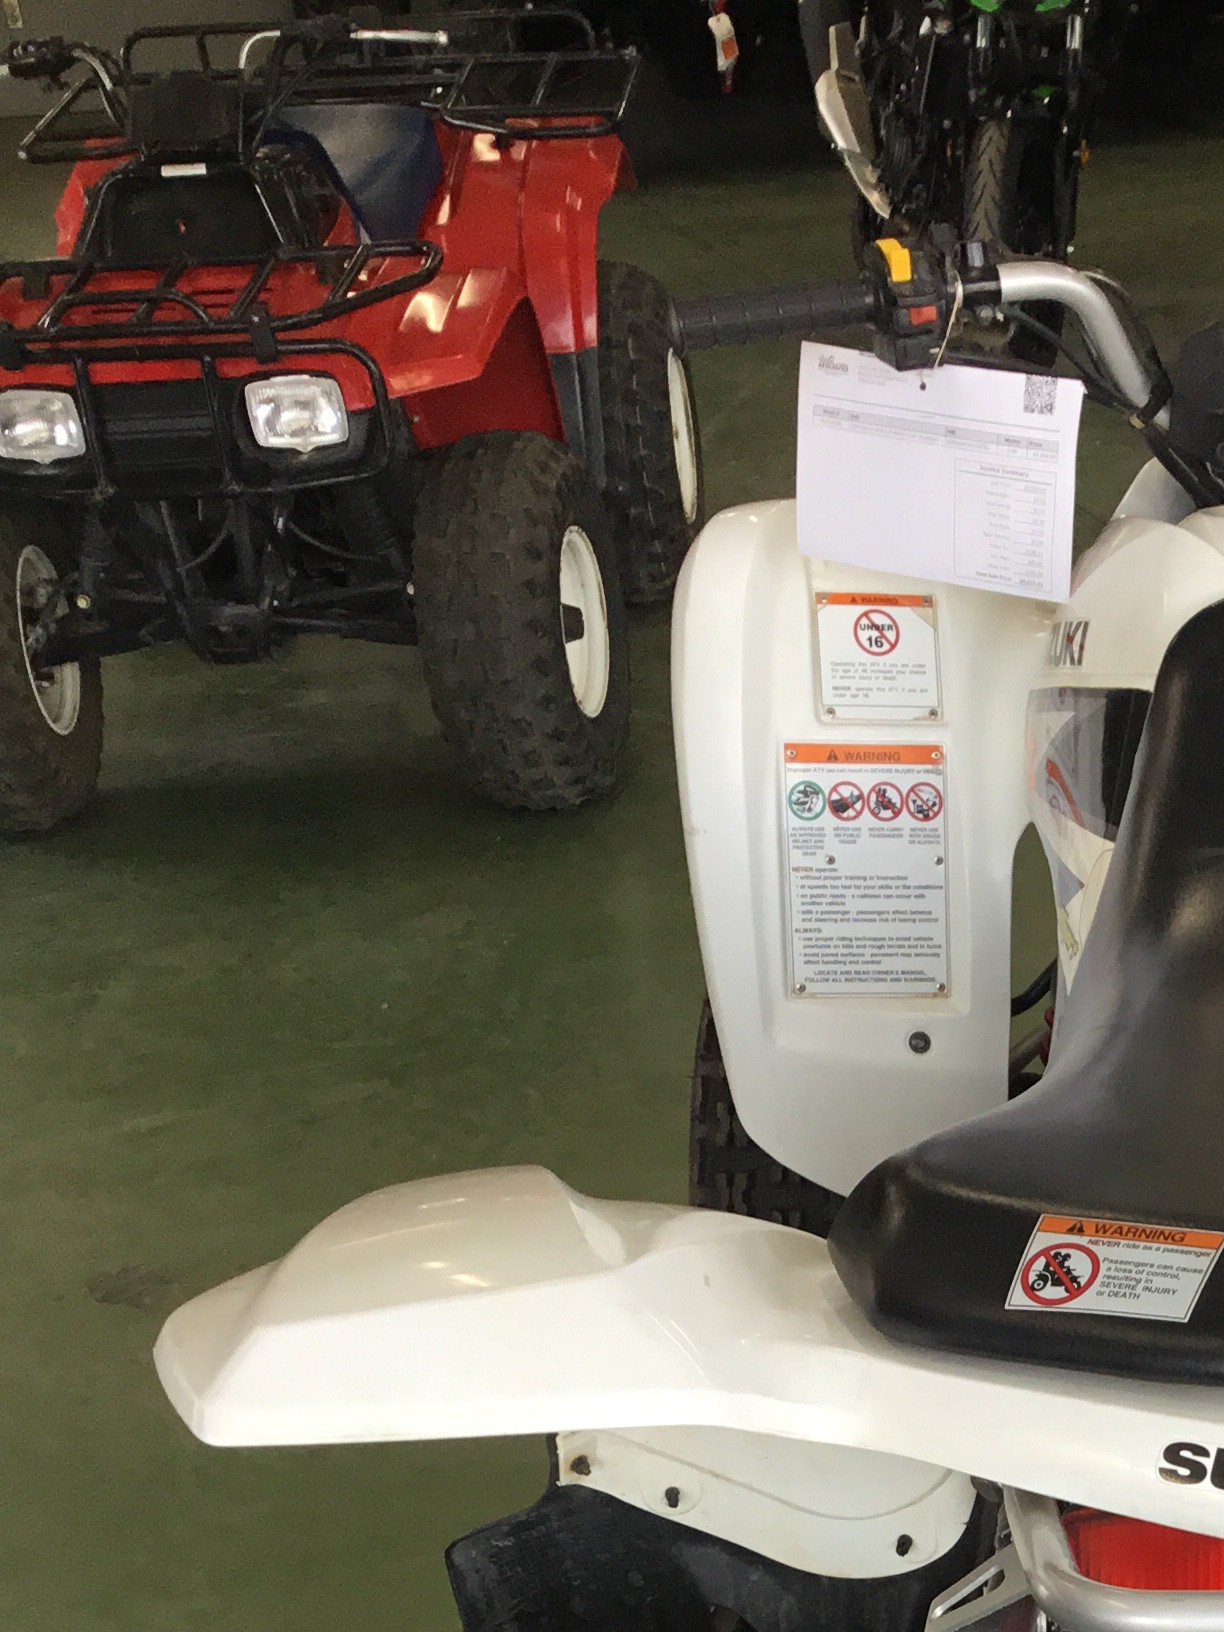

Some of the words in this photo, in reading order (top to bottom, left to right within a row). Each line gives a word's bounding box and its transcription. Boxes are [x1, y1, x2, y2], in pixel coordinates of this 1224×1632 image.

[859, 623, 894, 632] UNDER
[866, 635, 884, 648] 16
[843, 750, 901, 762] WARNING
[1094, 1223, 1187, 1243] WARNING
[1087, 1238, 1121, 1248] NEVER
[1122, 1242, 1140, 1250] ride
[1162, 1247, 1213, 1258] passenger
[1102, 1256, 1155, 1269] Passengers
[1176, 1265, 1204, 1274] cause
[1102, 1274, 1142, 1284] resulting
[1144, 1276, 1153, 1284] in
[1113, 1266, 1133, 1274] loss
[1135, 1268, 1145, 1276] of
[1146, 1270, 1181, 1281] control,
[1099, 1280, 1137, 1291] SEVERE
[1142, 1285, 1178, 1296] INJURY
[1107, 1289, 1141, 1300] DEATH
